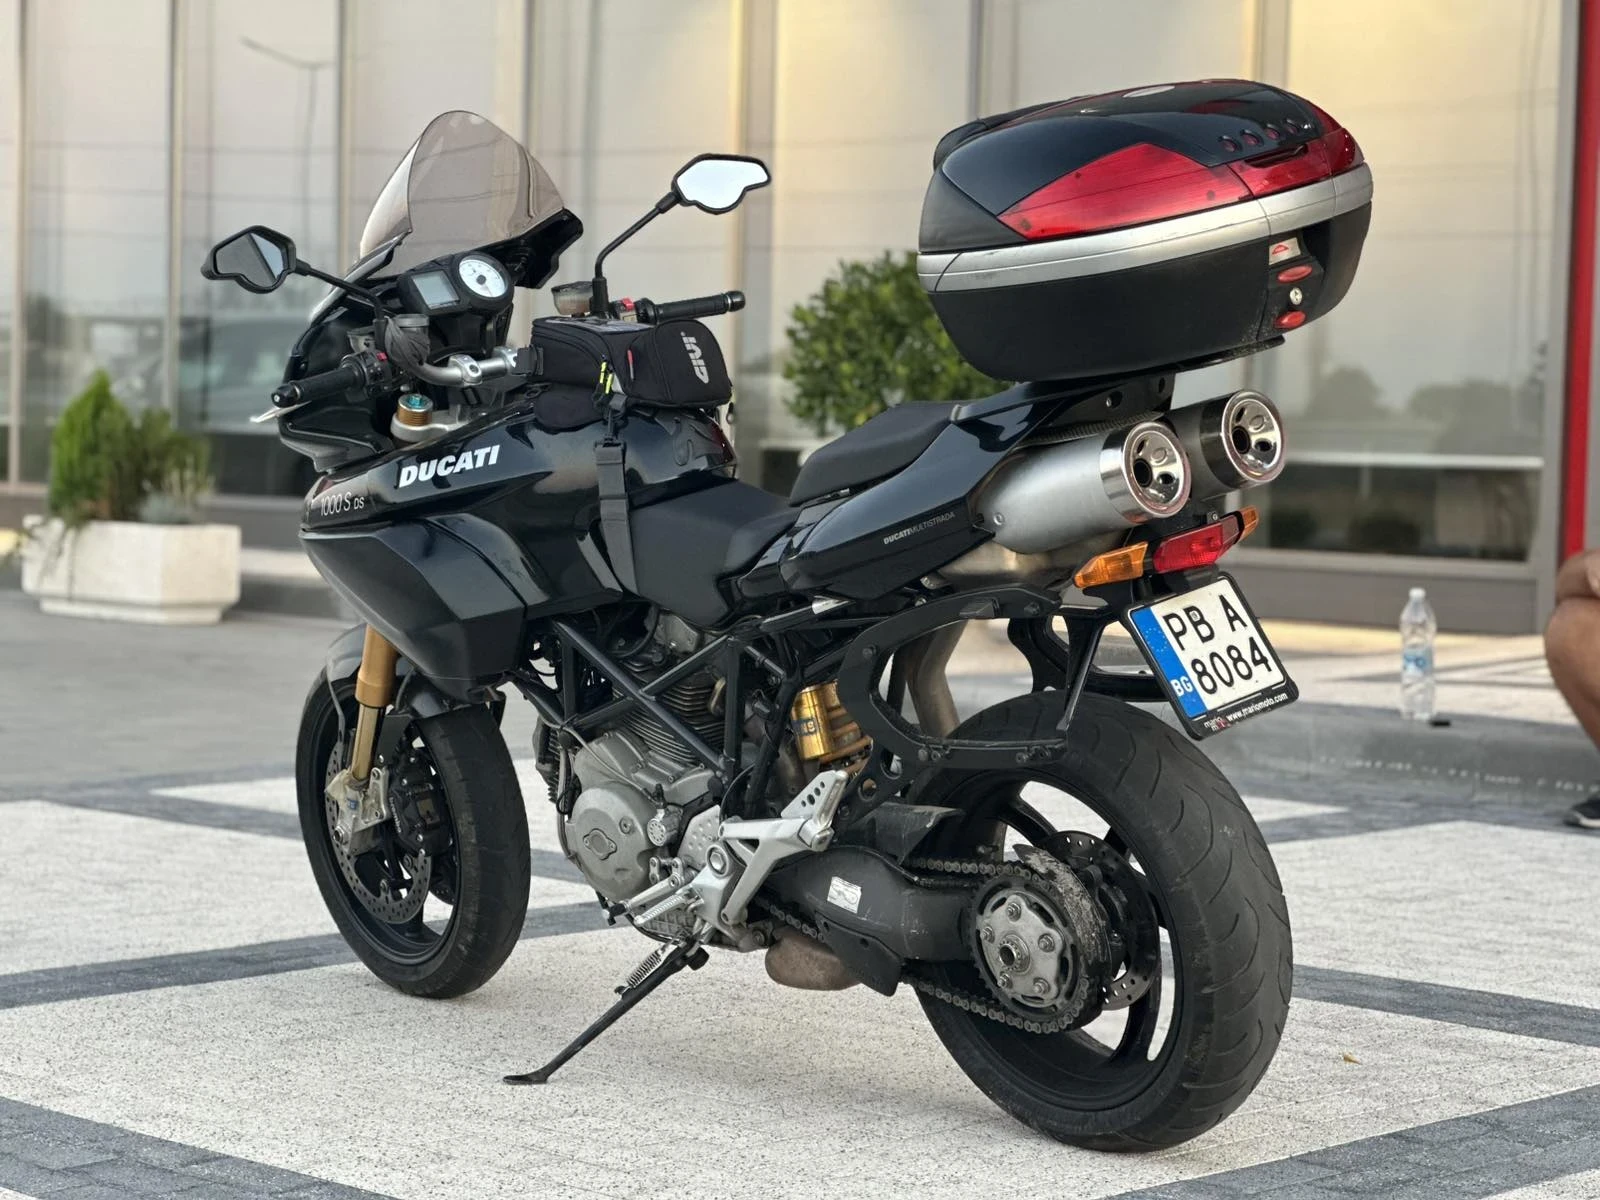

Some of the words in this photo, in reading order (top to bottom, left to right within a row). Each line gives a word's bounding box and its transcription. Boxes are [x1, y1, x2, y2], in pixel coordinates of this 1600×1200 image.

[681, 331, 709, 384] GIVI
[399, 444, 500, 488] DUCATI
[320, 493, 343, 516] 1000
[343, 491, 352, 511] S
[353, 497, 365, 510] DS
[1163, 605, 1215, 651] PB
[1219, 594, 1248, 632] A
[1170, 676, 1193, 697] BG
[1191, 636, 1272, 695] 8084
[1226, 692, 1288, 721] www.mariomoto.com
